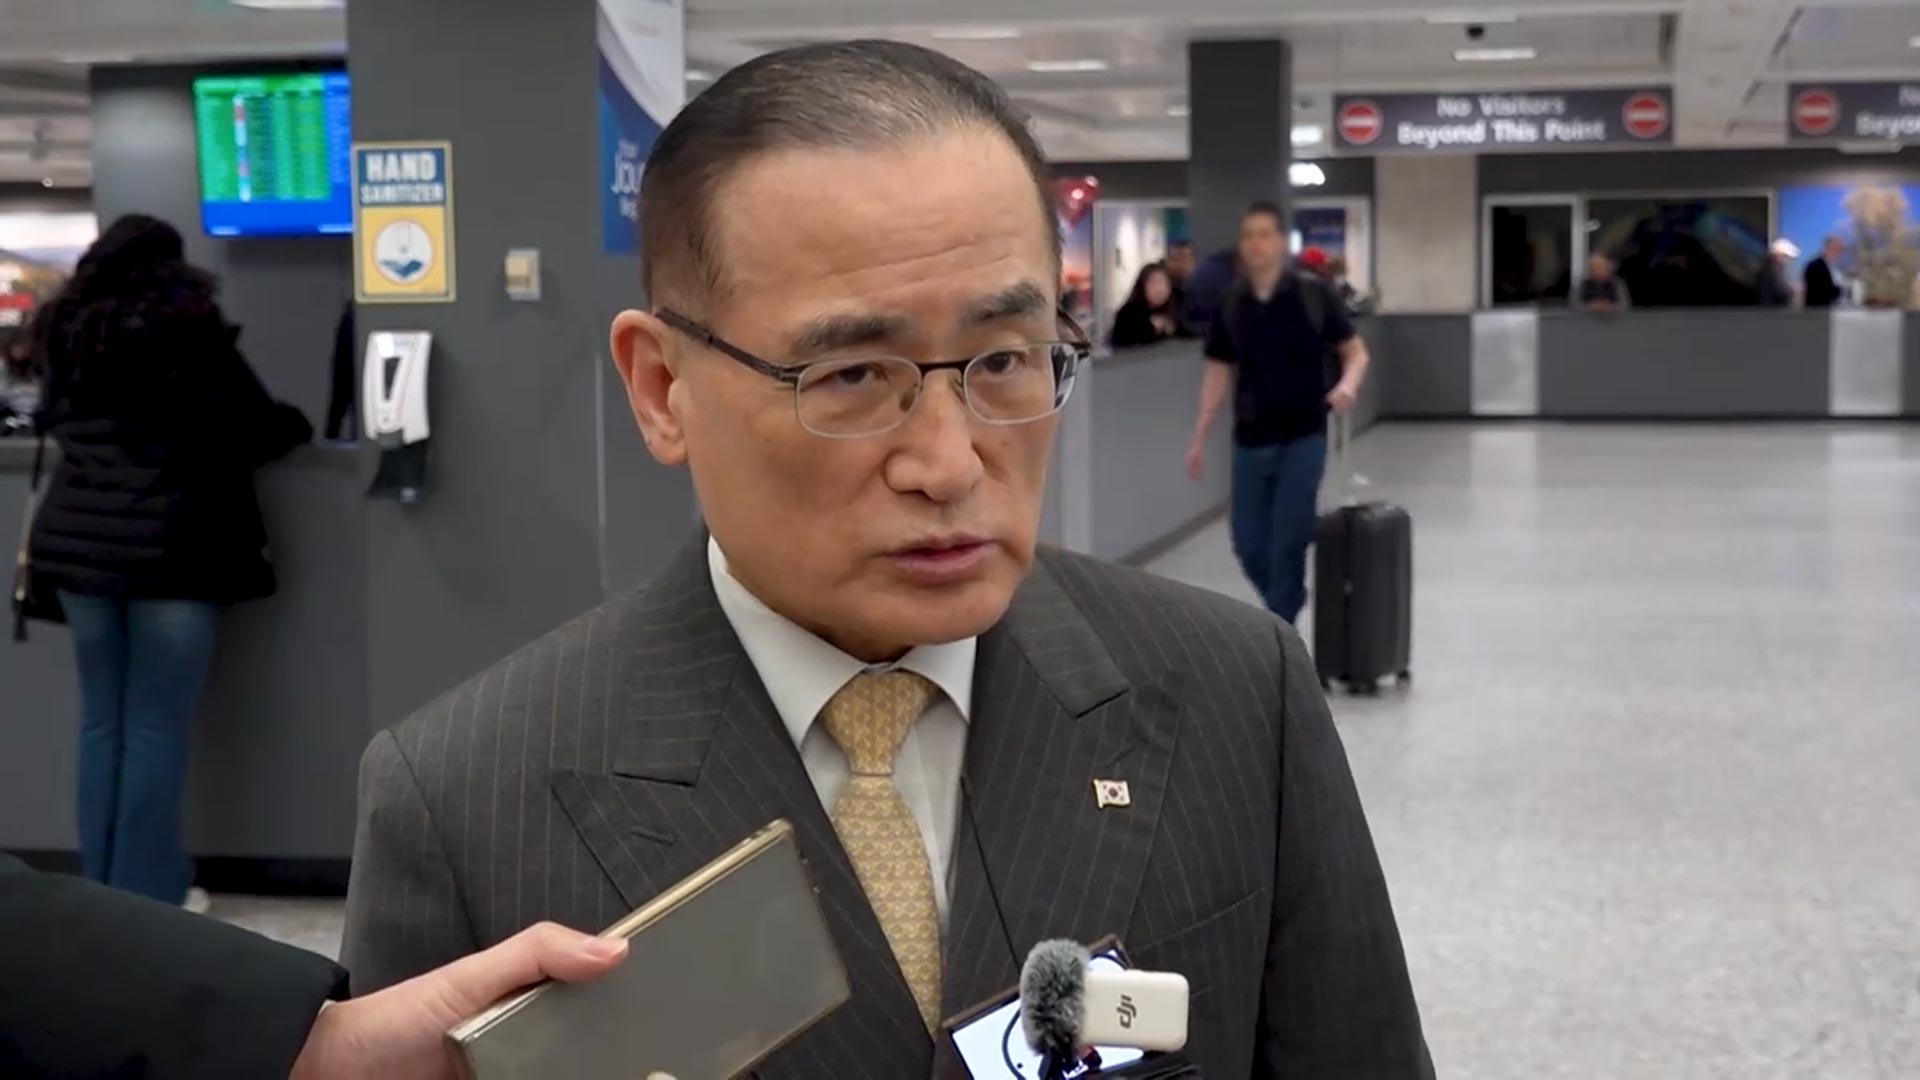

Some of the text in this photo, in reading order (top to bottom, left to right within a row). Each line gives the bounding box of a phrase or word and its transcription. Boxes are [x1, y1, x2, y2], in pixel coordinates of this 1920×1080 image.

[1437, 96, 1566, 116] No Visitors
[1398, 118, 1605, 148] Beyond This Point
[365, 151, 437, 182] HAND
[360, 183, 445, 204] SANITIZER
